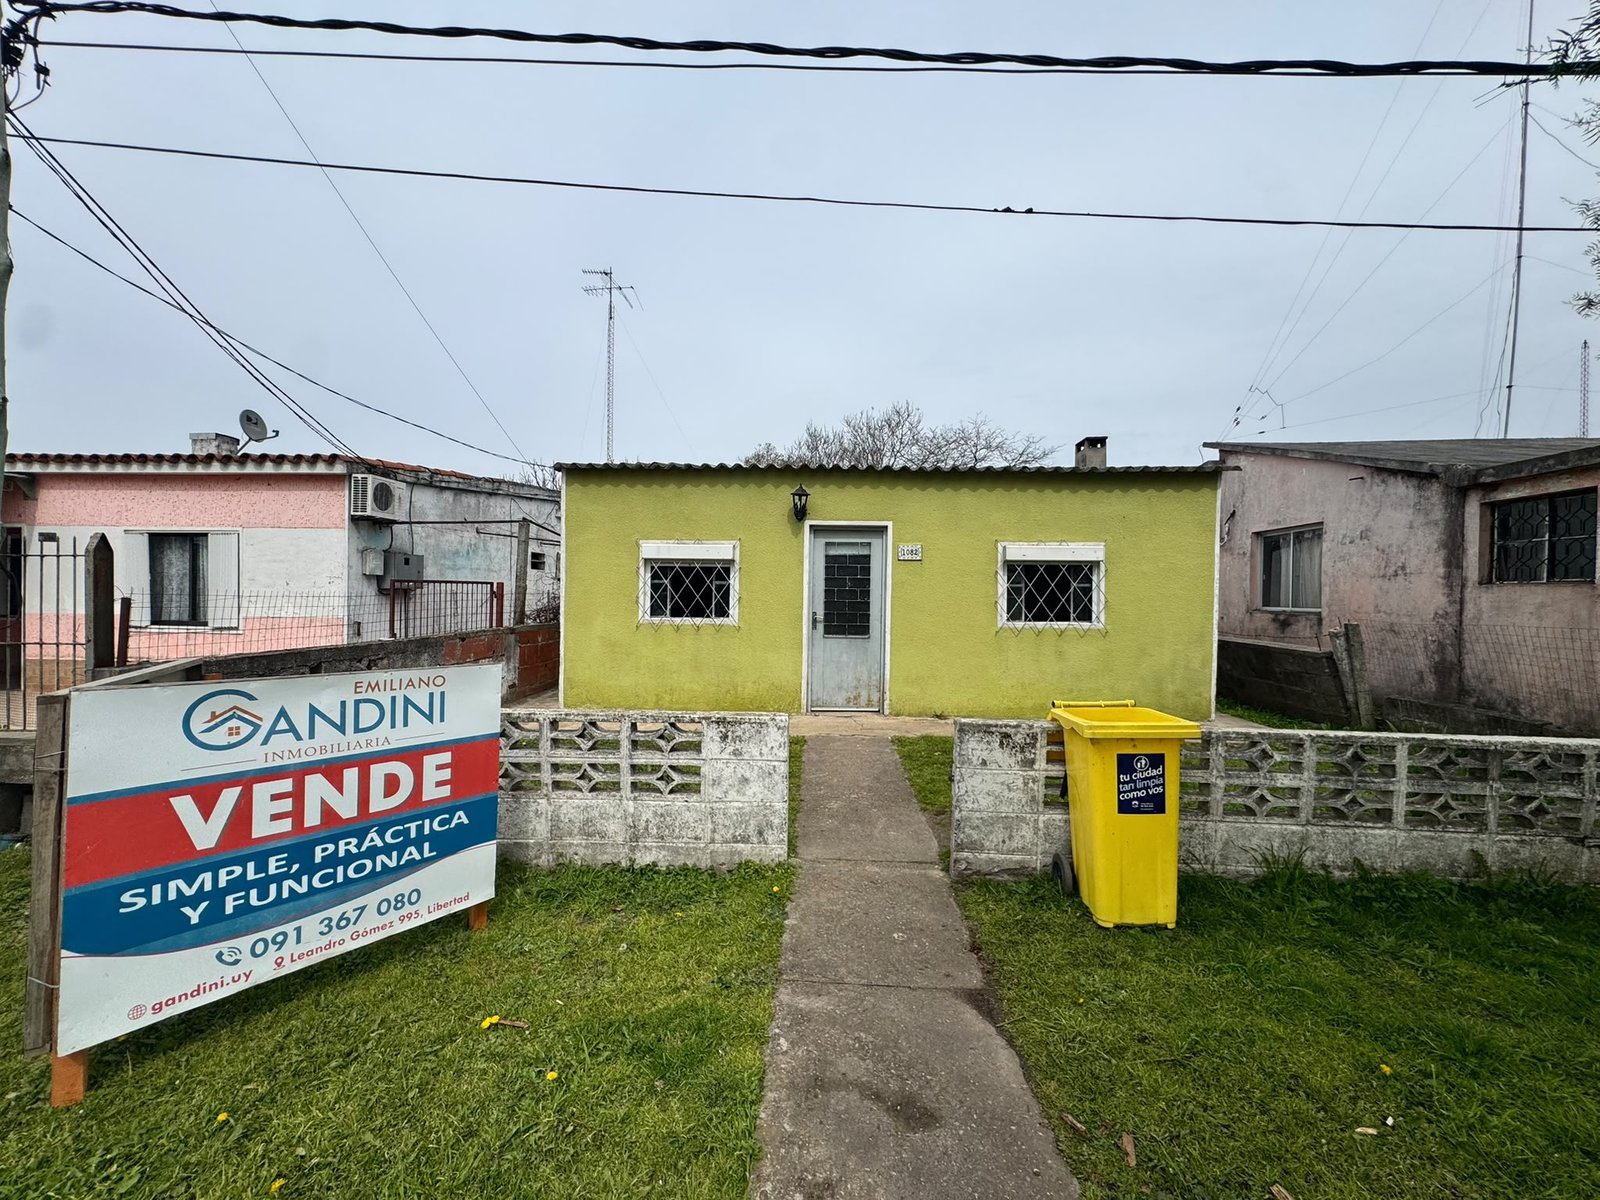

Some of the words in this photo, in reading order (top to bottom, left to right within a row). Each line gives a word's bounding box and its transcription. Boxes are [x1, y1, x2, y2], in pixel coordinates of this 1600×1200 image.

[353, 675, 446, 695] EMILIANO
[182, 688, 446, 751] GANDINI
[263, 736, 391, 763] INMOBILIARIA
[1132, 765, 1162, 779] ciudad
[169, 751, 452, 851] VENDE
[1119, 783, 1135, 791] tan
[1136, 776, 1163, 788] limpia
[1120, 790, 1146, 800] como
[1148, 786, 1163, 794] vos
[119, 854, 300, 913] SIMPLE,
[314, 810, 469, 863] PRÁCTICA
[180, 905, 208, 926] Y
[225, 841, 437, 915] FUNCIONAL
[249, 925, 303, 959] 091
[318, 906, 365, 937] 367
[376, 888, 422, 916] 080
[289, 938, 346, 964] Leandro
[350, 920, 395, 942] Gómez
[398, 909, 424, 925] 995,
[427, 892, 470, 914] Libertad
[151, 968, 253, 1015] gandini.uy
